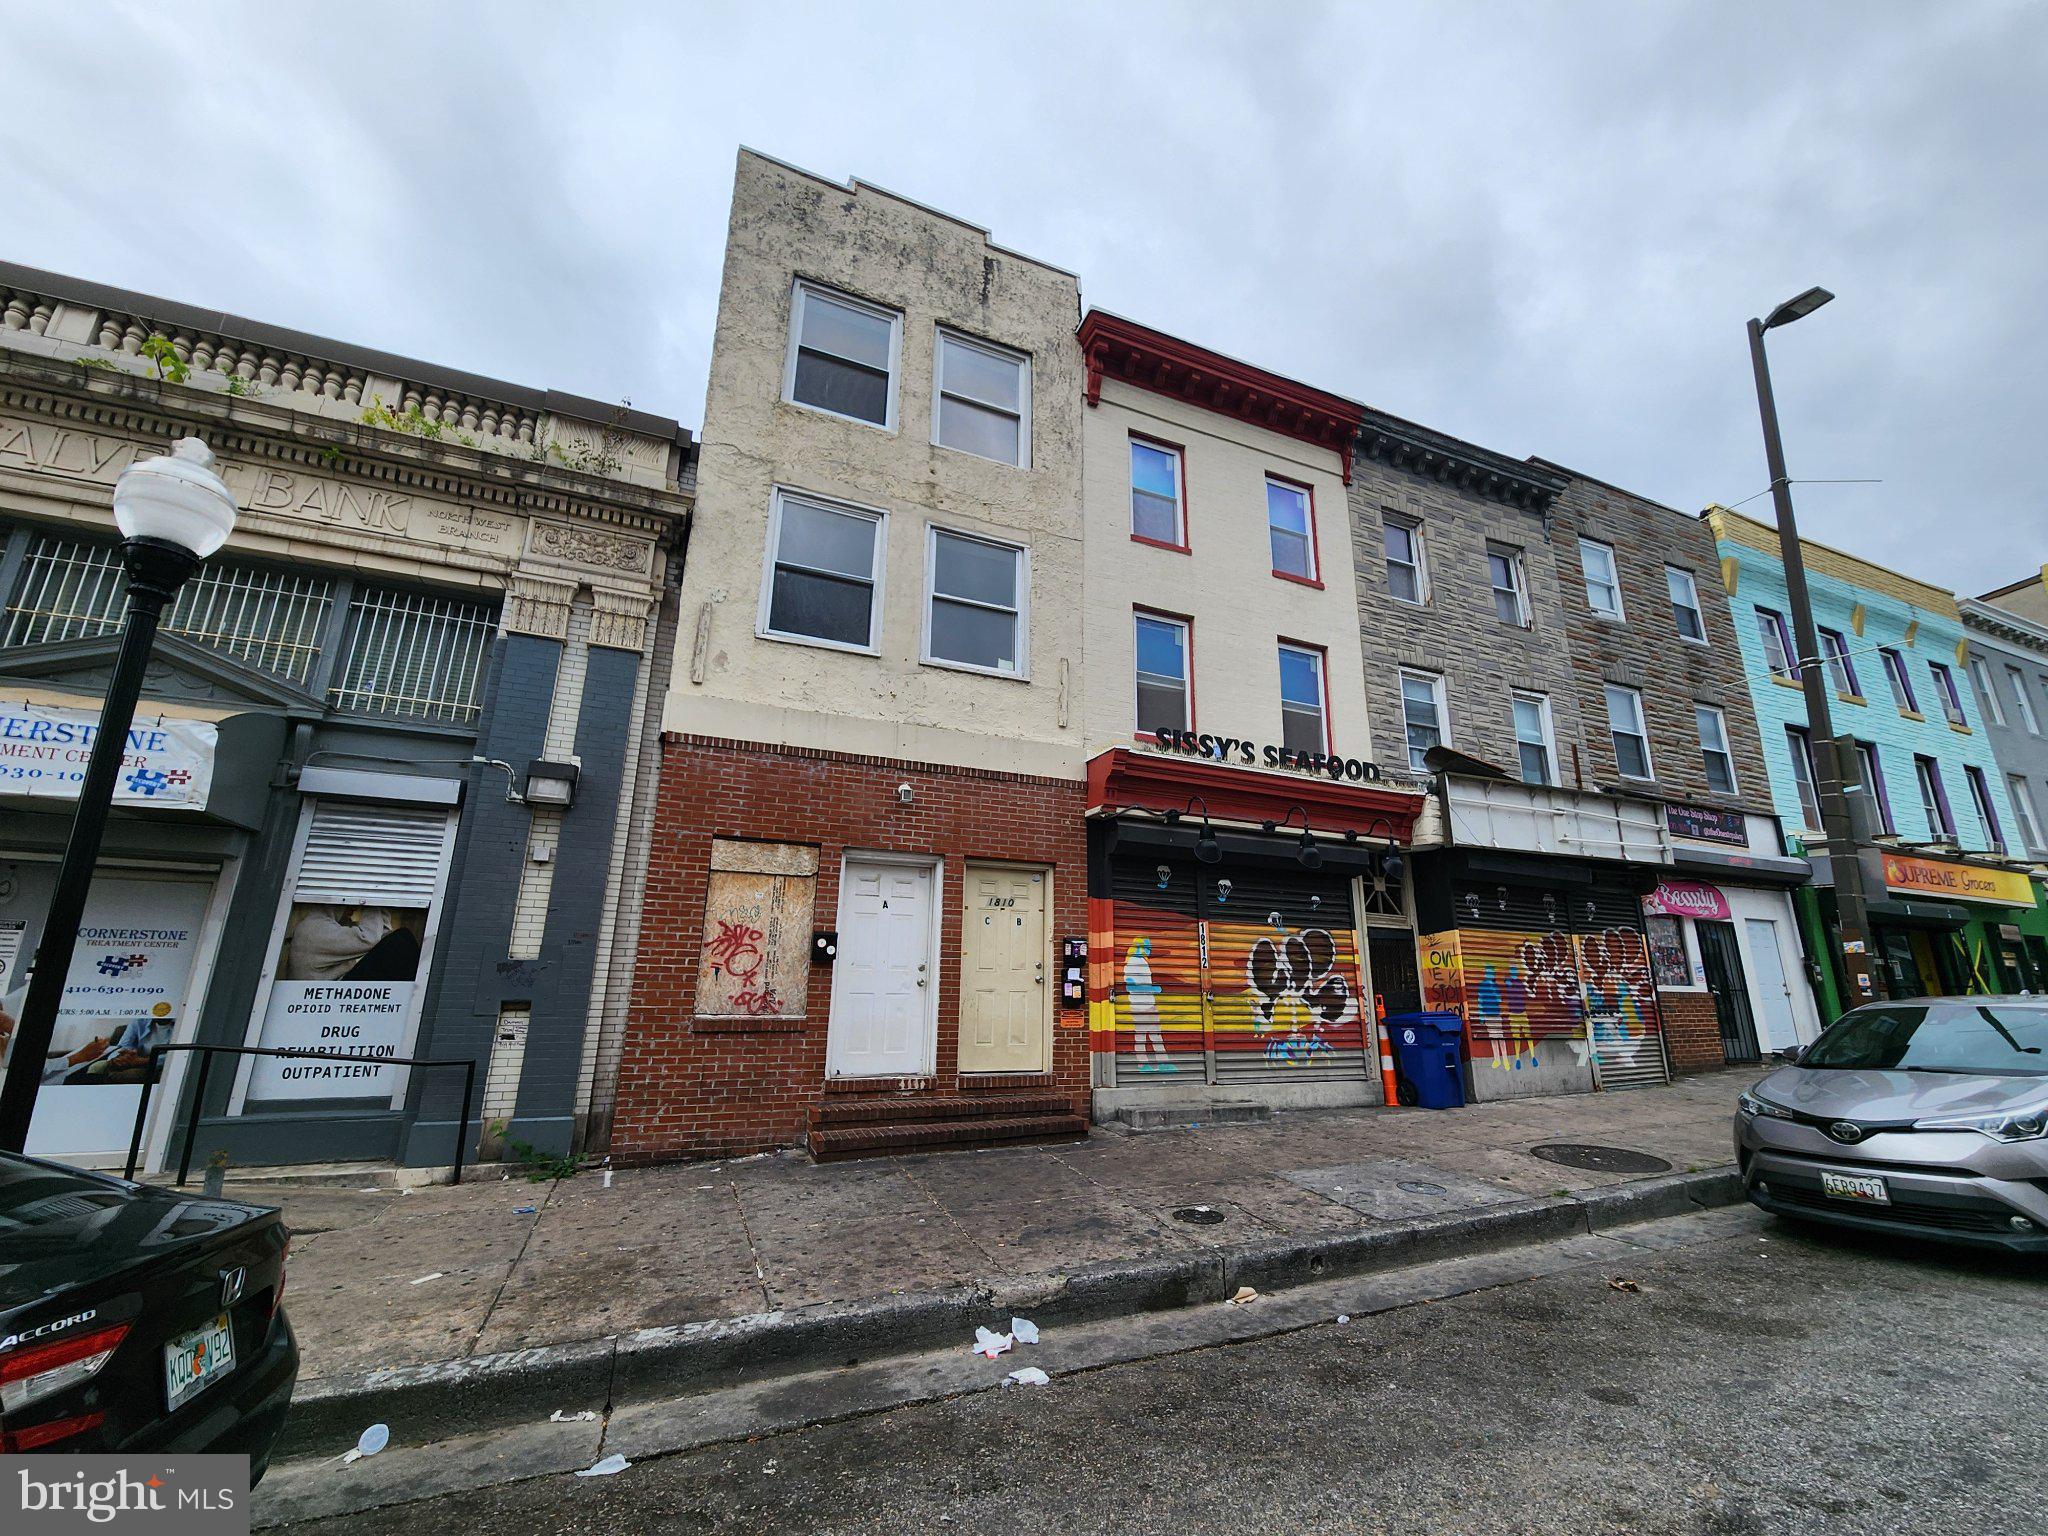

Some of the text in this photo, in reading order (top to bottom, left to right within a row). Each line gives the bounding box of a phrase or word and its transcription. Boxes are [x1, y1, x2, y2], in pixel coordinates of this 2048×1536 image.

[254, 471, 409, 531] BANK
[427, 509, 511, 532] NORTH WEST
[438, 525, 499, 543] BRANCH
[0, 743, 60, 760] MENT
[1155, 727, 1380, 780] SISSY'S SEAFOOD
[1895, 863, 1996, 891] SUPREME Grocers
[882, 900, 889, 909] A
[988, 899, 1015, 907] 1810
[1658, 883, 1719, 915] Beauty
[984, 916, 991, 925] C
[1016, 917, 1022, 926] B
[77, 928, 188, 940] CORNERSTONE
[86, 940, 179, 948] TREATMENT CENTER
[1200, 923, 1208, 968] 1812
[65, 985, 165, 994] 410-630-1090
[303, 988, 391, 1000] METHADONE
[287, 1004, 402, 1013] OPIOID TREATMENT
[321, 1026, 360, 1038] DRUG
[282, 1065, 382, 1079] OUTPATIENT
[0, 1310, 96, 1350] ACCORD
